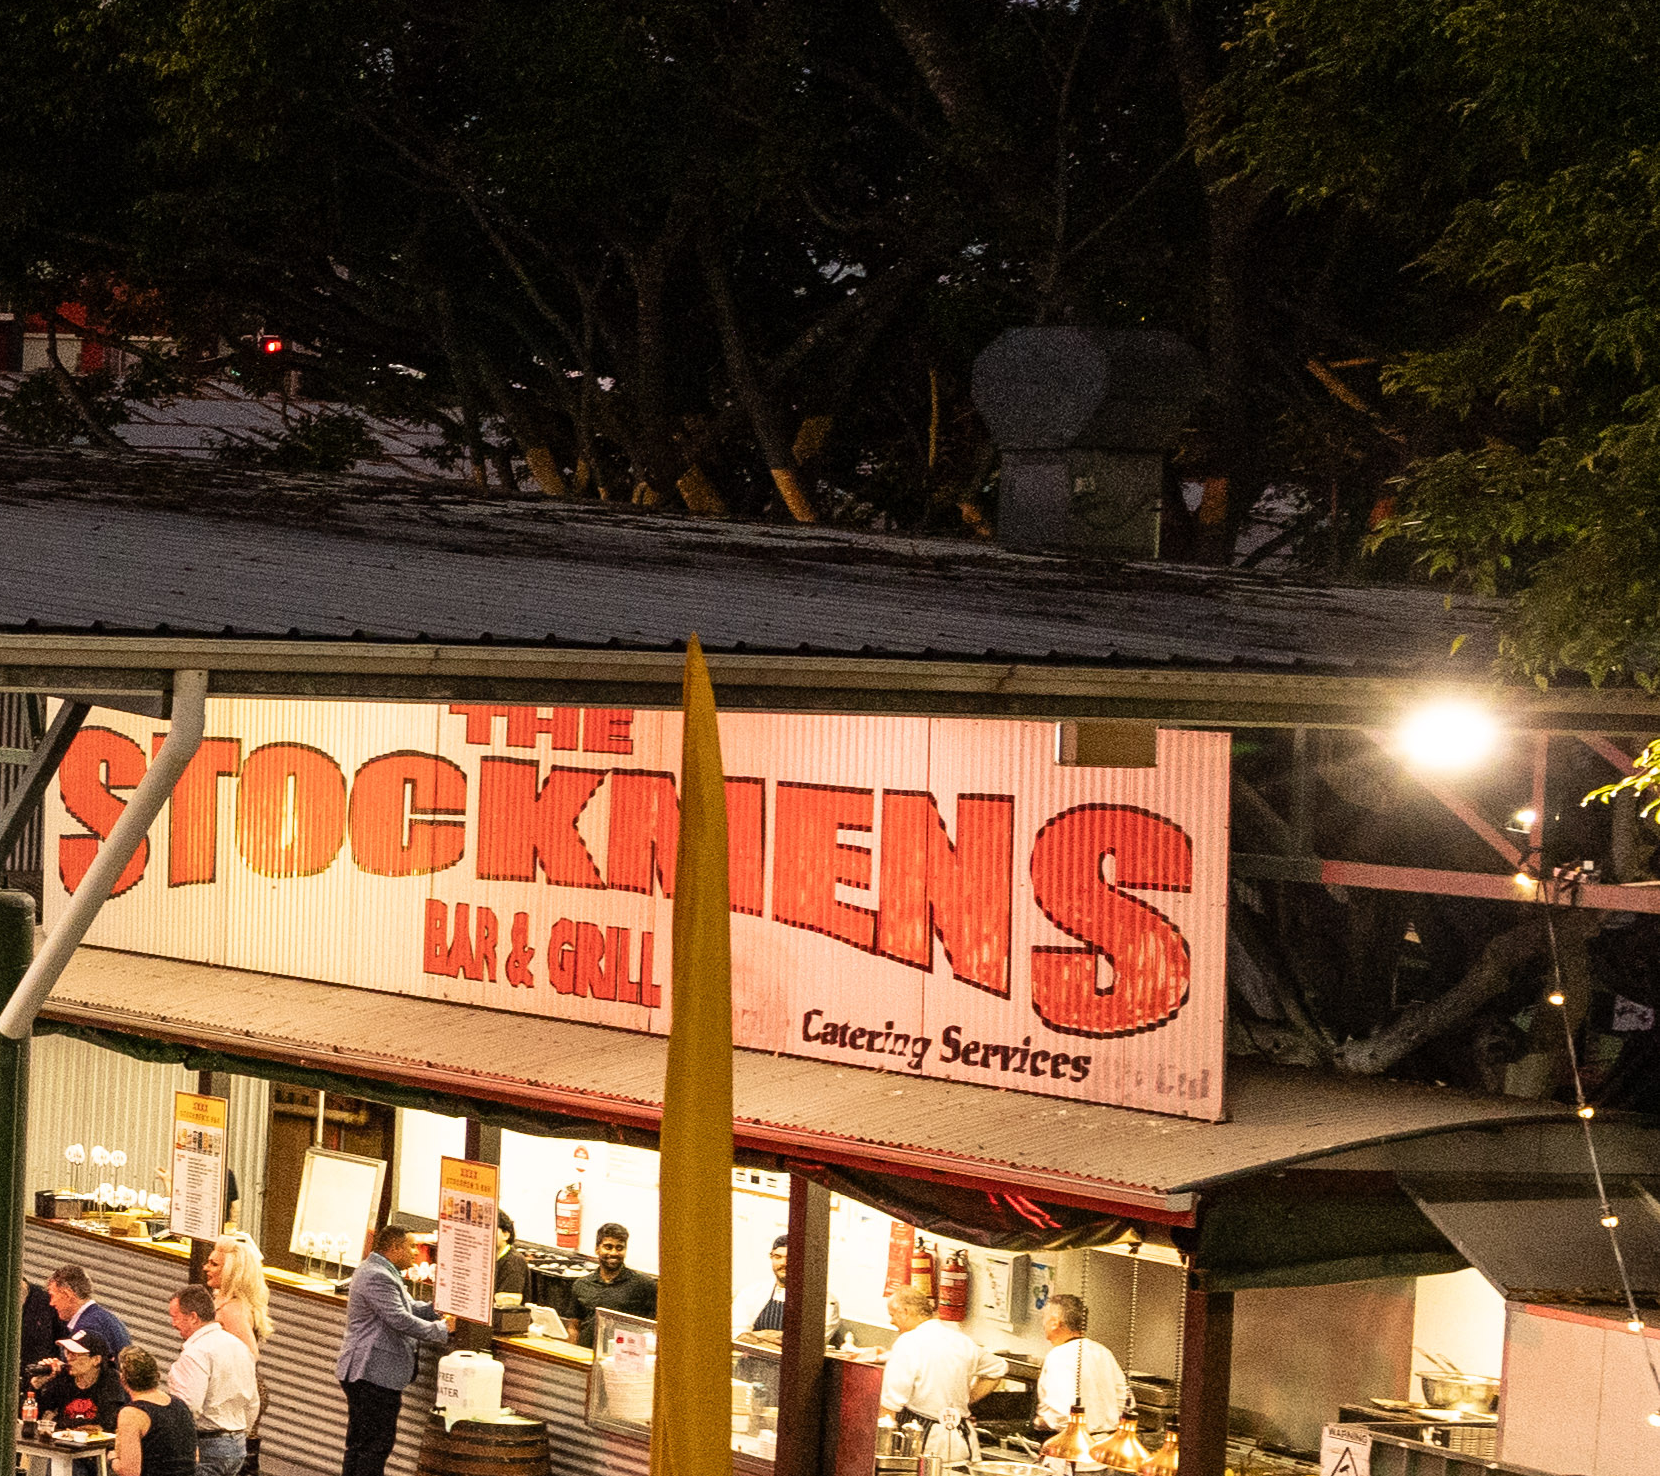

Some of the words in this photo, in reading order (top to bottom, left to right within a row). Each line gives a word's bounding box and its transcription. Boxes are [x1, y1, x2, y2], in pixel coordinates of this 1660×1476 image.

[448, 703, 635, 756] THE
[58, 723, 1194, 1040] STOCKMENS
[423, 897, 499, 983] BAR
[505, 910, 535, 989] &
[547, 916, 662, 1009] GRILL
[801, 1008, 932, 1070] Catering
[938, 1024, 1093, 1083] Services
[438, 1371, 455, 1383] FREE
[438, 1386, 459, 1398] ATER
[1328, 1426, 1368, 1444] WARNING
